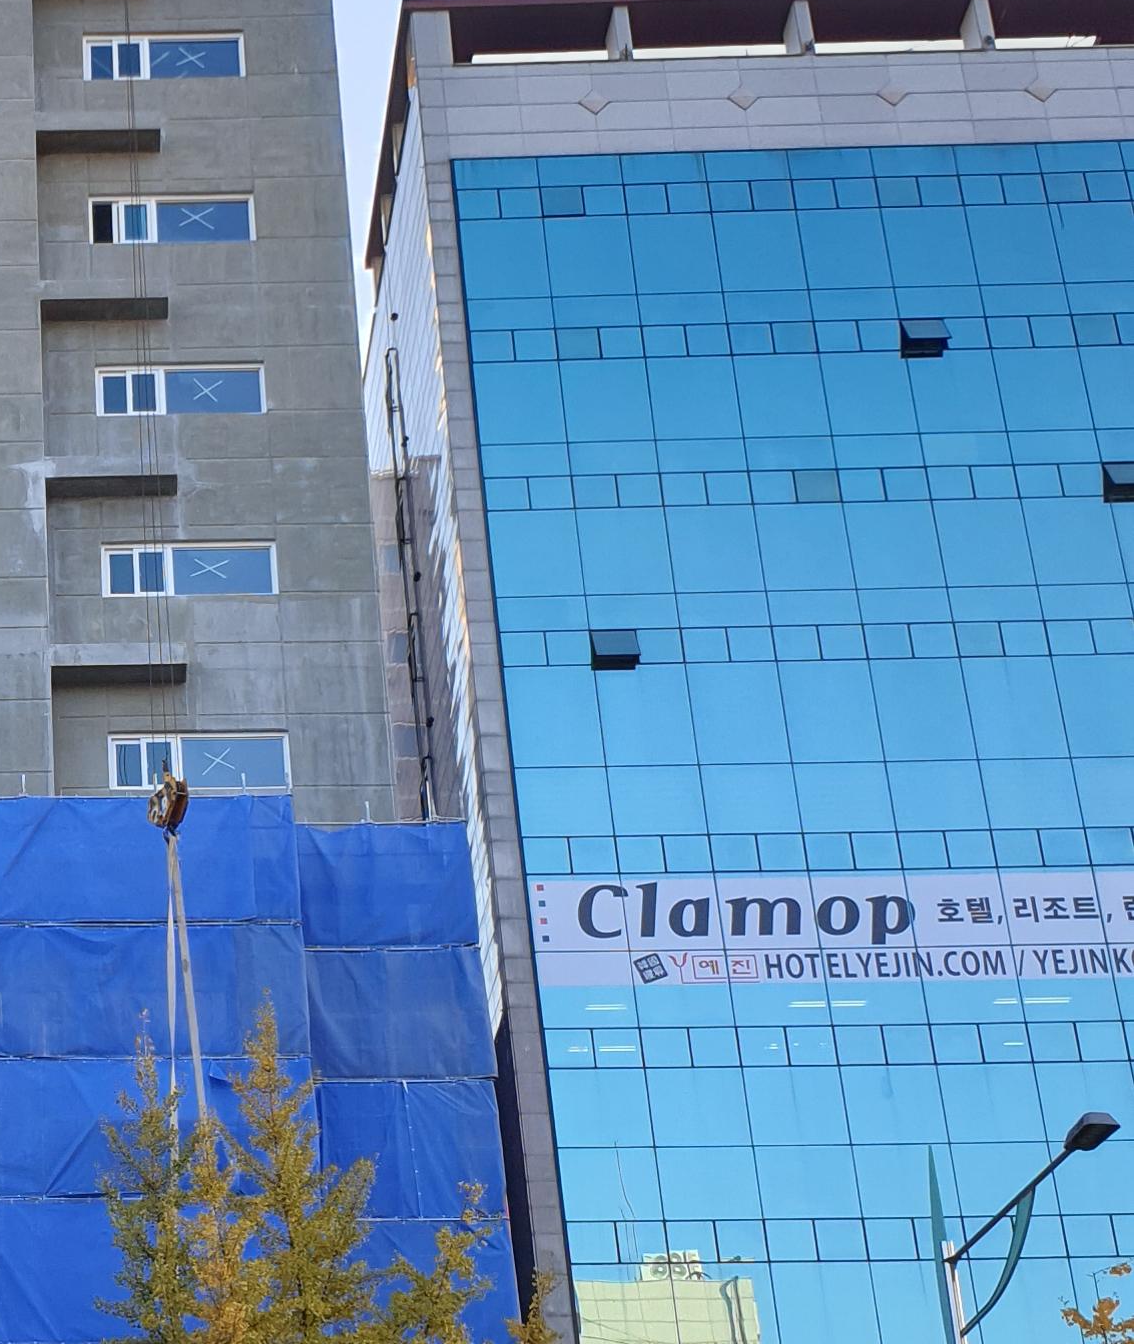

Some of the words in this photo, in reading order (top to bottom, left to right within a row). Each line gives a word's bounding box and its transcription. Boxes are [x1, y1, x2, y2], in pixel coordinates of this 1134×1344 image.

[578, 882, 915, 945] Clamop
[765, 950, 1007, 980] HOTELYEJIN.COM
[1032, 948, 1134, 976] YEJINK
